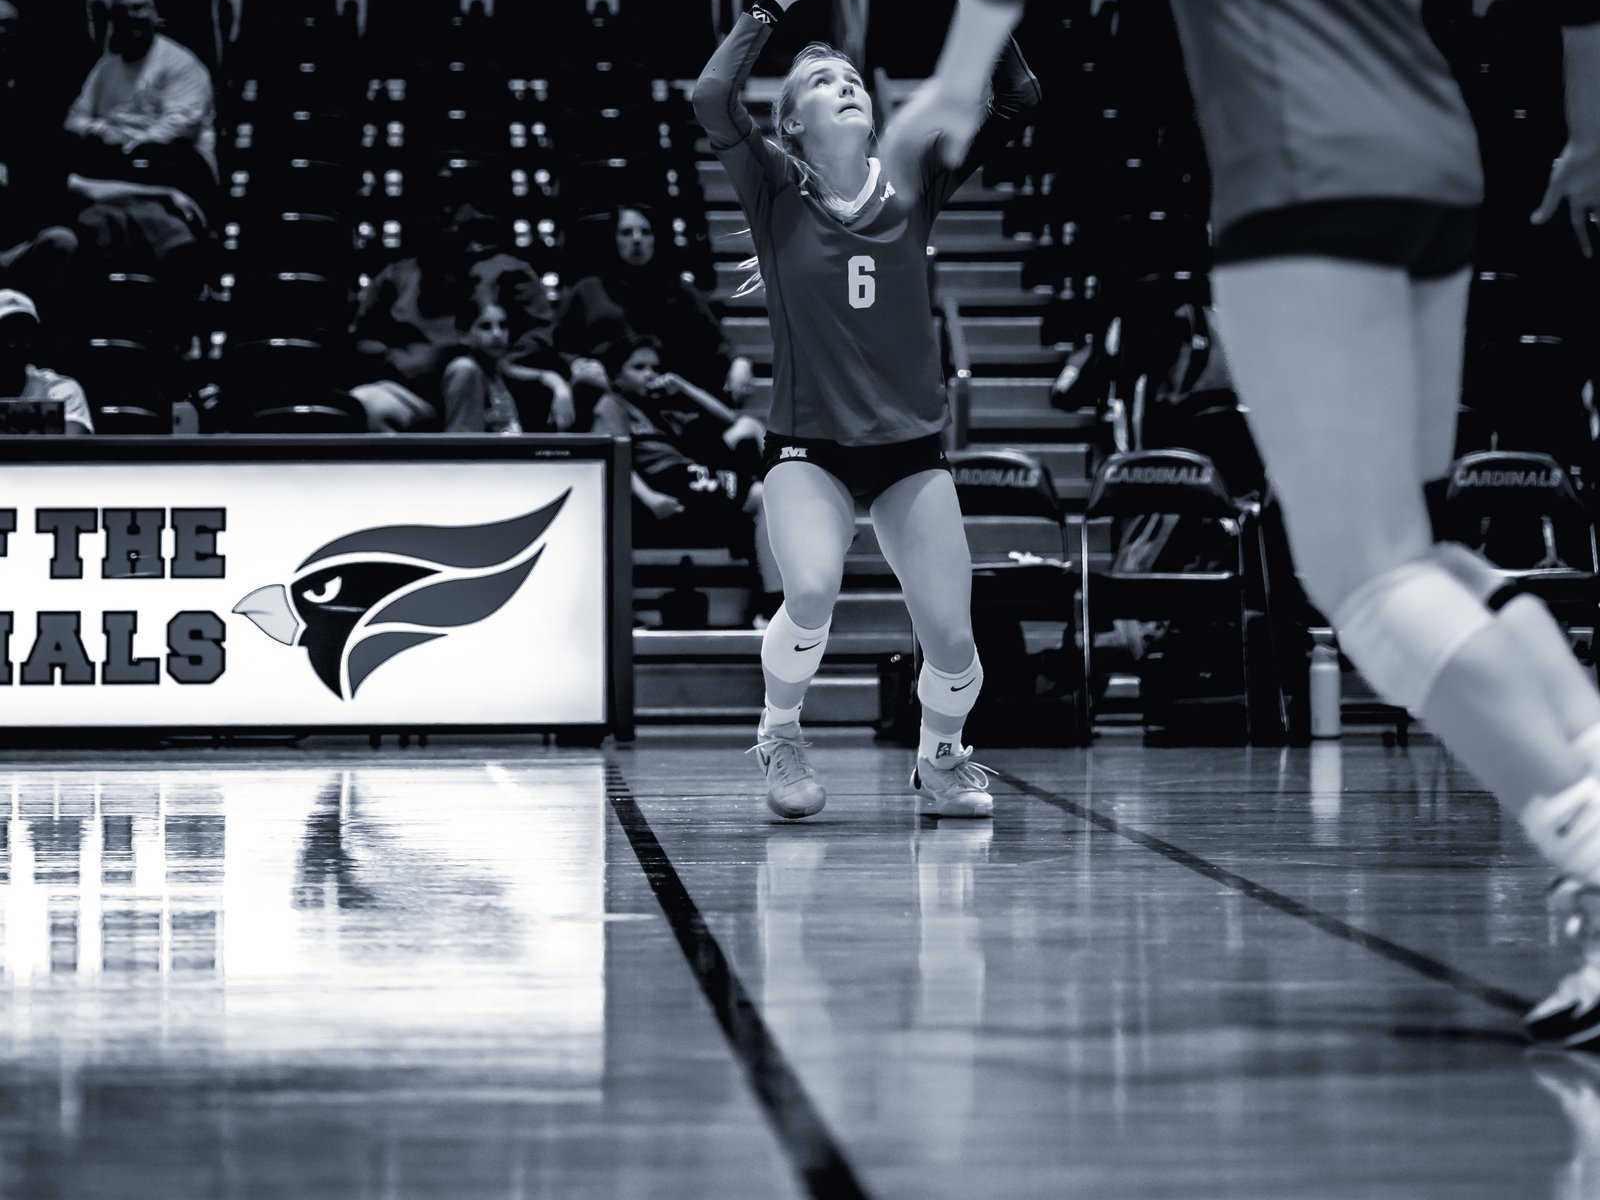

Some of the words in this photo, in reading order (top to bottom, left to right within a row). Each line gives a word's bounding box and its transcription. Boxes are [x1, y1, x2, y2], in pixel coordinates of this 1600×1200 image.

[847, 255, 876, 309] 6
[1104, 465, 1213, 486] CARDINALS
[1455, 467, 1562, 488] CARDINALS
[35, 507, 227, 580] THE
